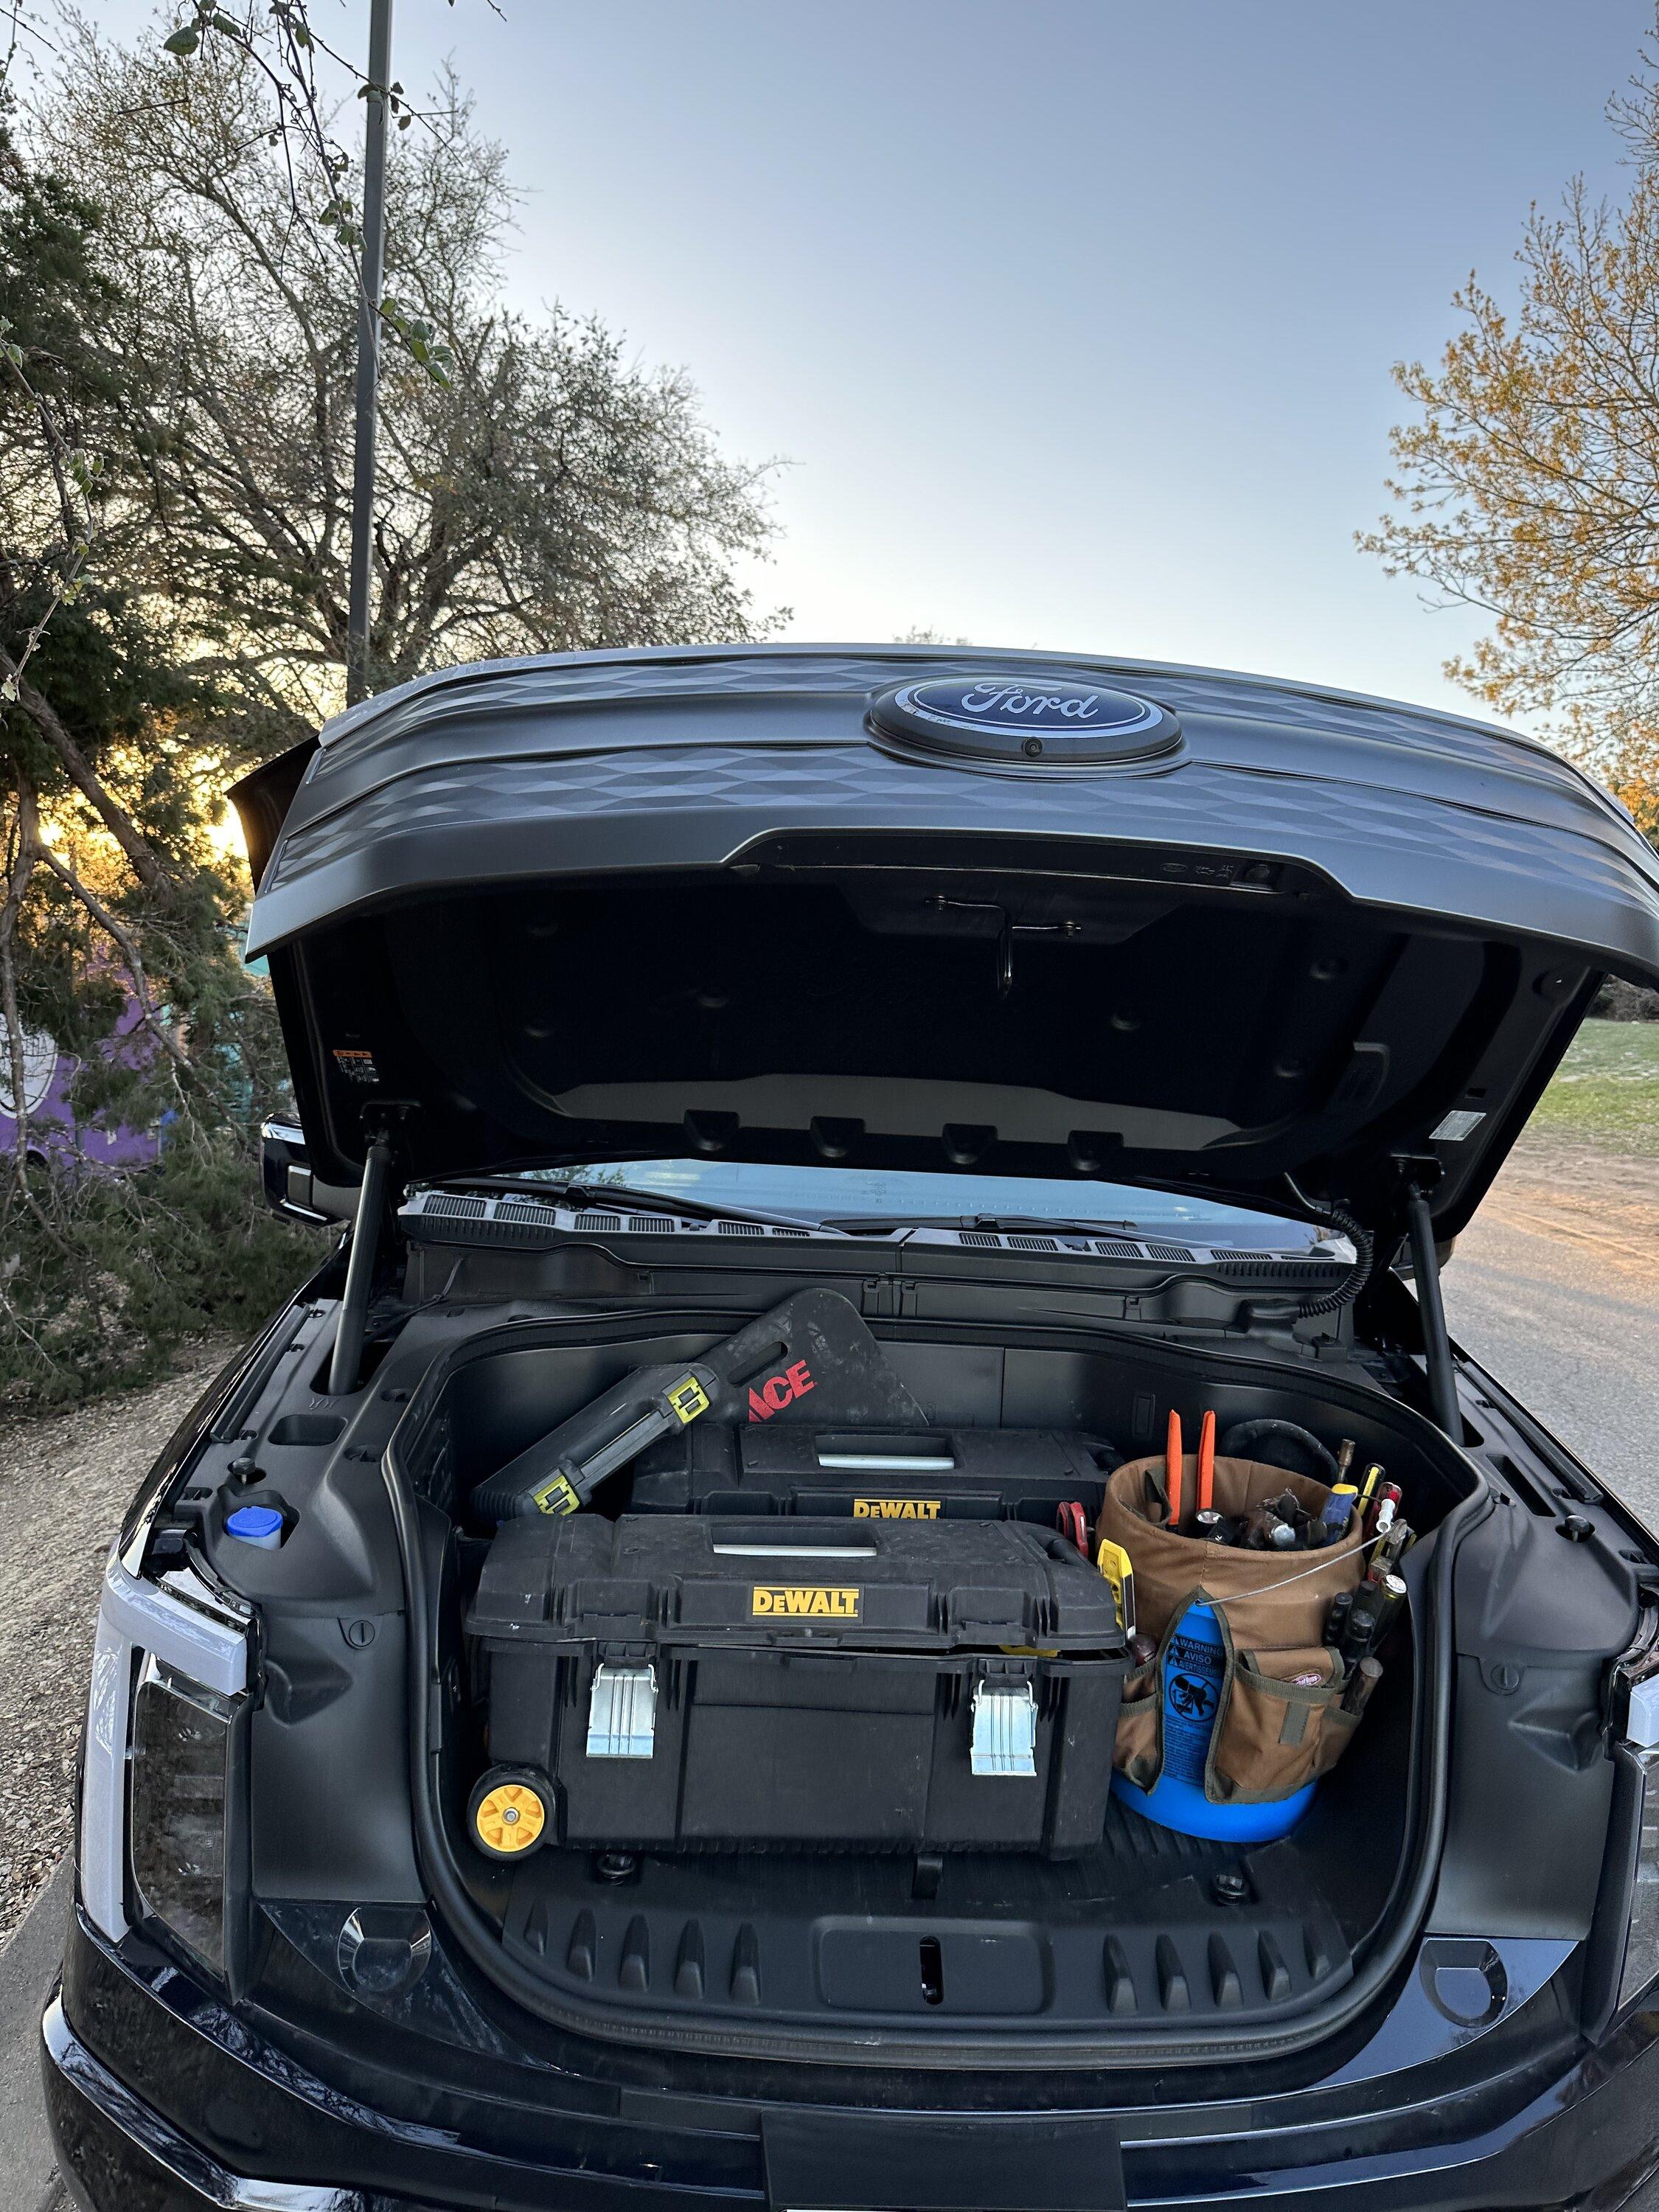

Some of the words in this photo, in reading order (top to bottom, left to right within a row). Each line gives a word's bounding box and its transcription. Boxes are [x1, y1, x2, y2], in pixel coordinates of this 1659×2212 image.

[961, 683, 1099, 719] Ford
[748, 1359, 815, 1422] ACE
[1180, 1638, 1223, 1656] WARNING
[1183, 1651, 1211, 1664] AVISO
